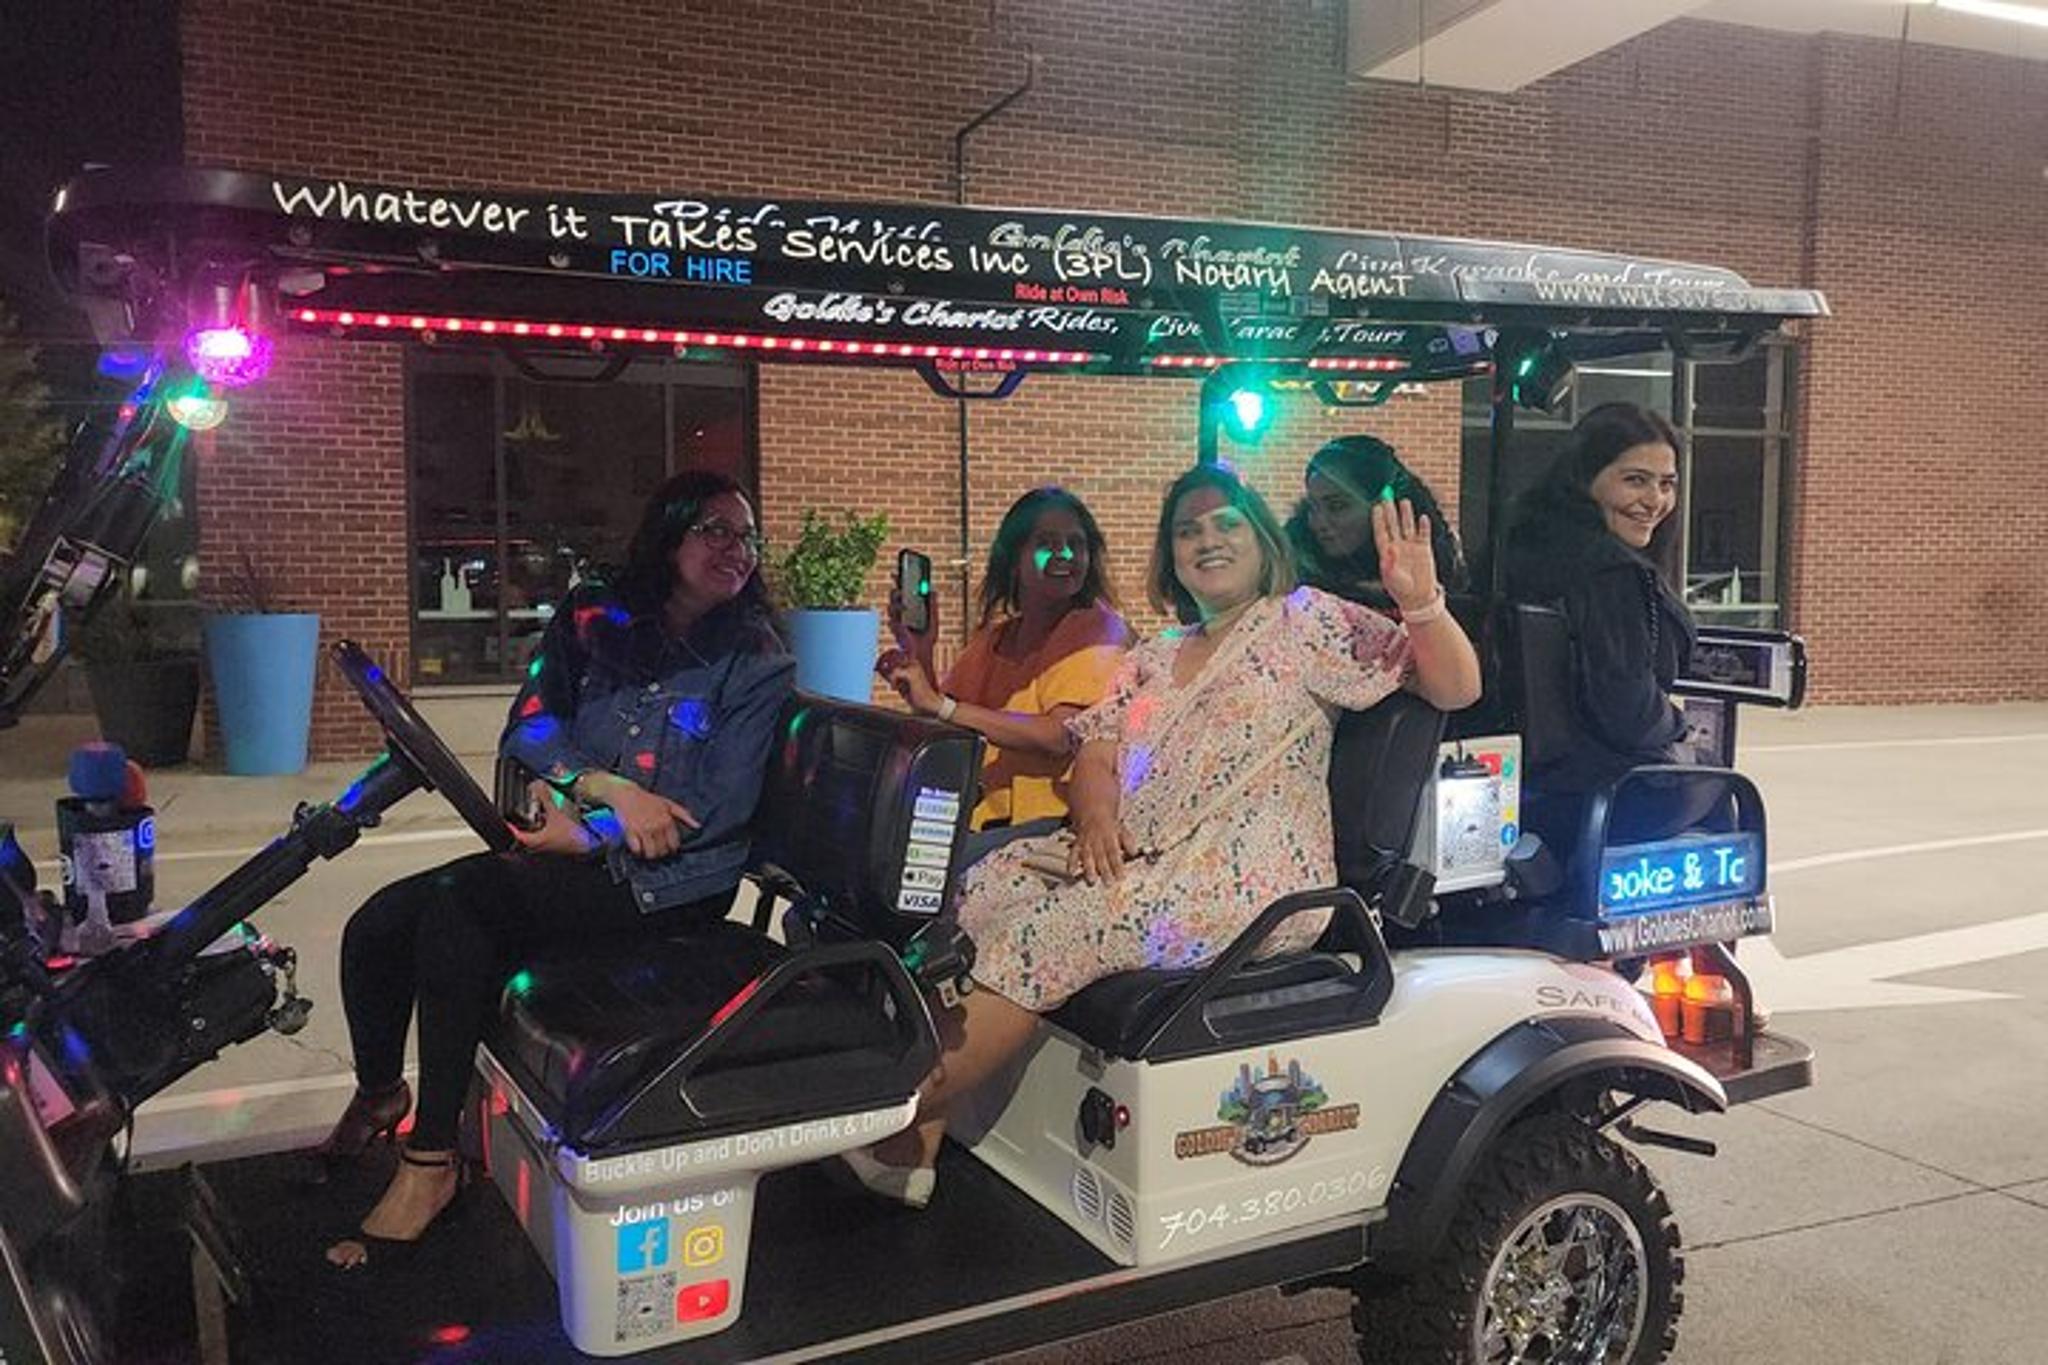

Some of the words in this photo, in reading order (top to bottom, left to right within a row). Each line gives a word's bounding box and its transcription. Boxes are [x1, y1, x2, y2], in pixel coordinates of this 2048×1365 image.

[272, 182, 530, 234] Whatever
[548, 205, 588, 239] it
[969, 246, 1030, 275] Inc
[1053, 249, 1154, 286] (3PL)
[1175, 260, 1291, 296] Notary
[610, 249, 671, 277] FOR
[687, 254, 752, 285] HIRE
[1014, 282, 1047, 300] Ride
[1066, 286, 1099, 302] Own
[763, 293, 897, 324] Goldie's
[901, 301, 1024, 330] Chariot
[1026, 305, 1120, 334] Rides,
[919, 871, 942, 887] Pay
[1683, 852, 1704, 890] &
[904, 893, 939, 908] VISA
[584, 1155, 655, 1183] Buckle
[662, 1147, 688, 1172] Up
[694, 1137, 730, 1165] and
[736, 1128, 783, 1156] Don't
[790, 1113, 840, 1146] Drink
[844, 1117, 856, 1135] &
[610, 1202, 664, 1226] Join
[673, 1194, 704, 1214] us
[1160, 1166, 1386, 1249] 704.380.0306
